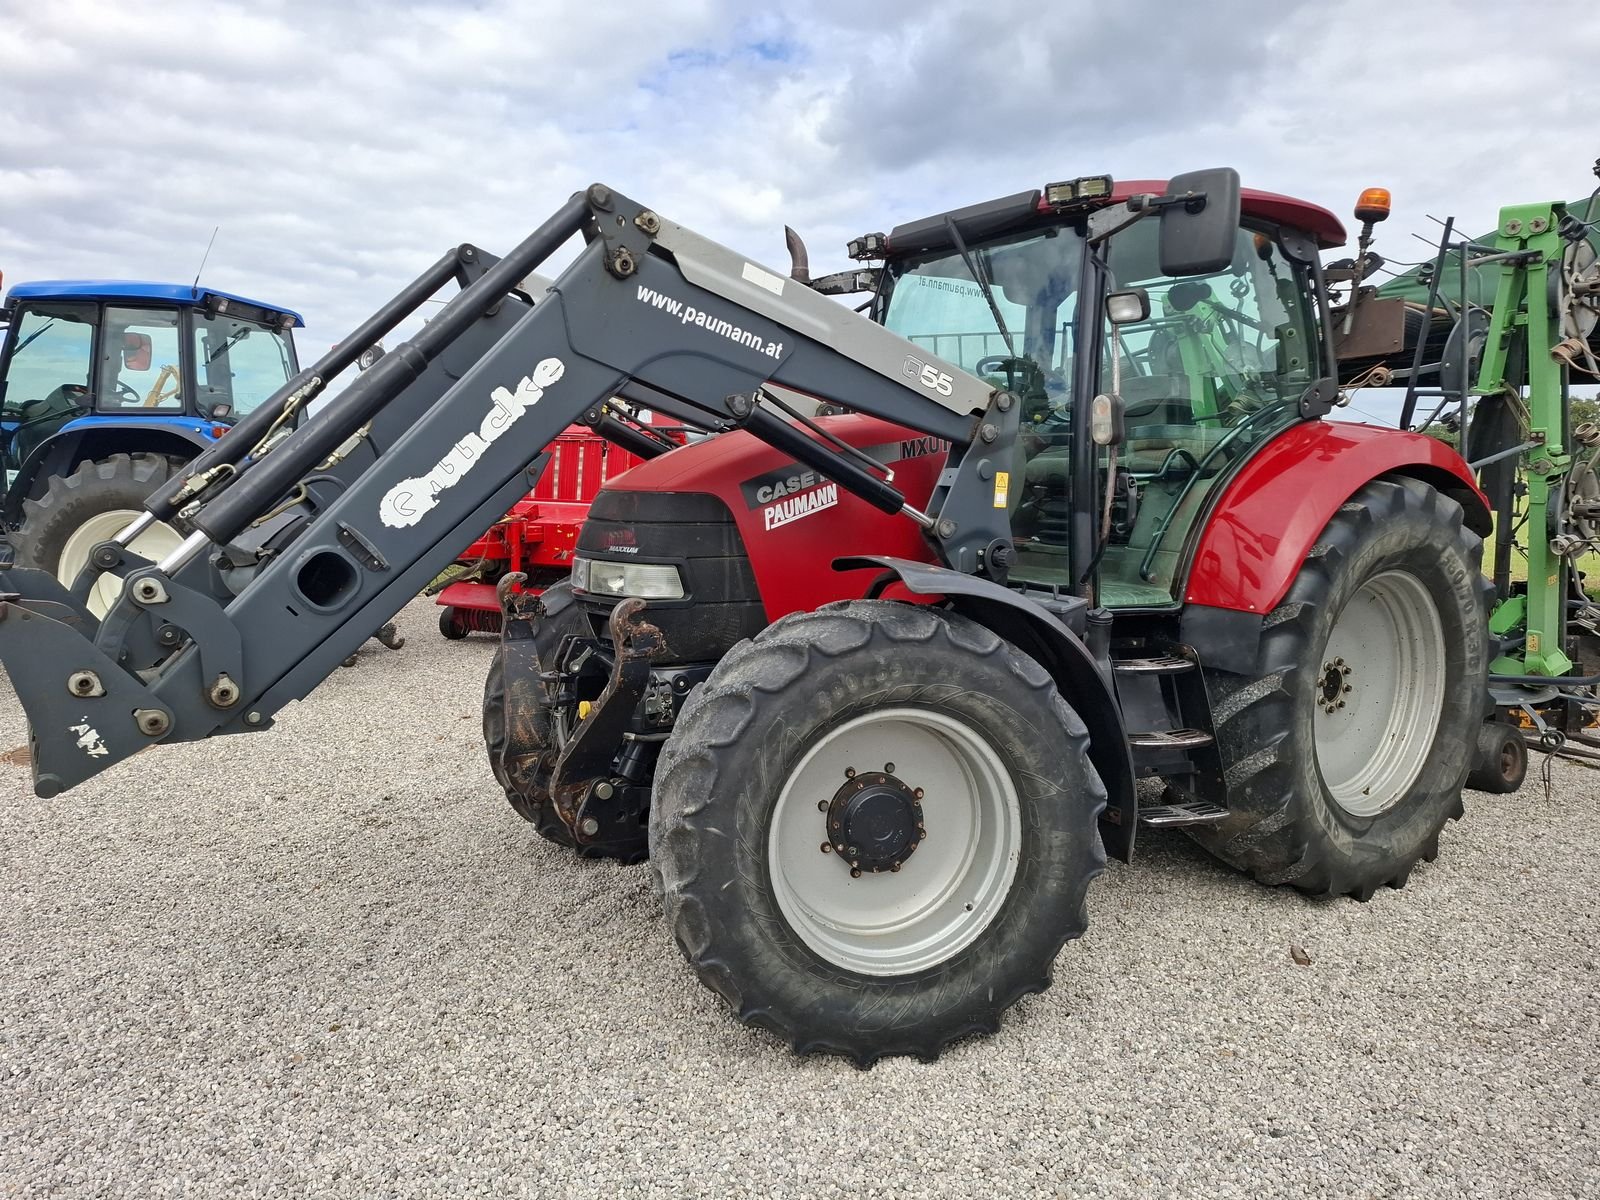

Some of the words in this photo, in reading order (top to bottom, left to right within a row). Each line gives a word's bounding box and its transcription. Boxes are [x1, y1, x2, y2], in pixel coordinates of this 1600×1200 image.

[637, 285, 783, 360] www.paumann.at
[757, 471, 815, 503] CASE
[764, 483, 838, 531] PAUMANN
[609, 545, 638, 554] MAXXUM
